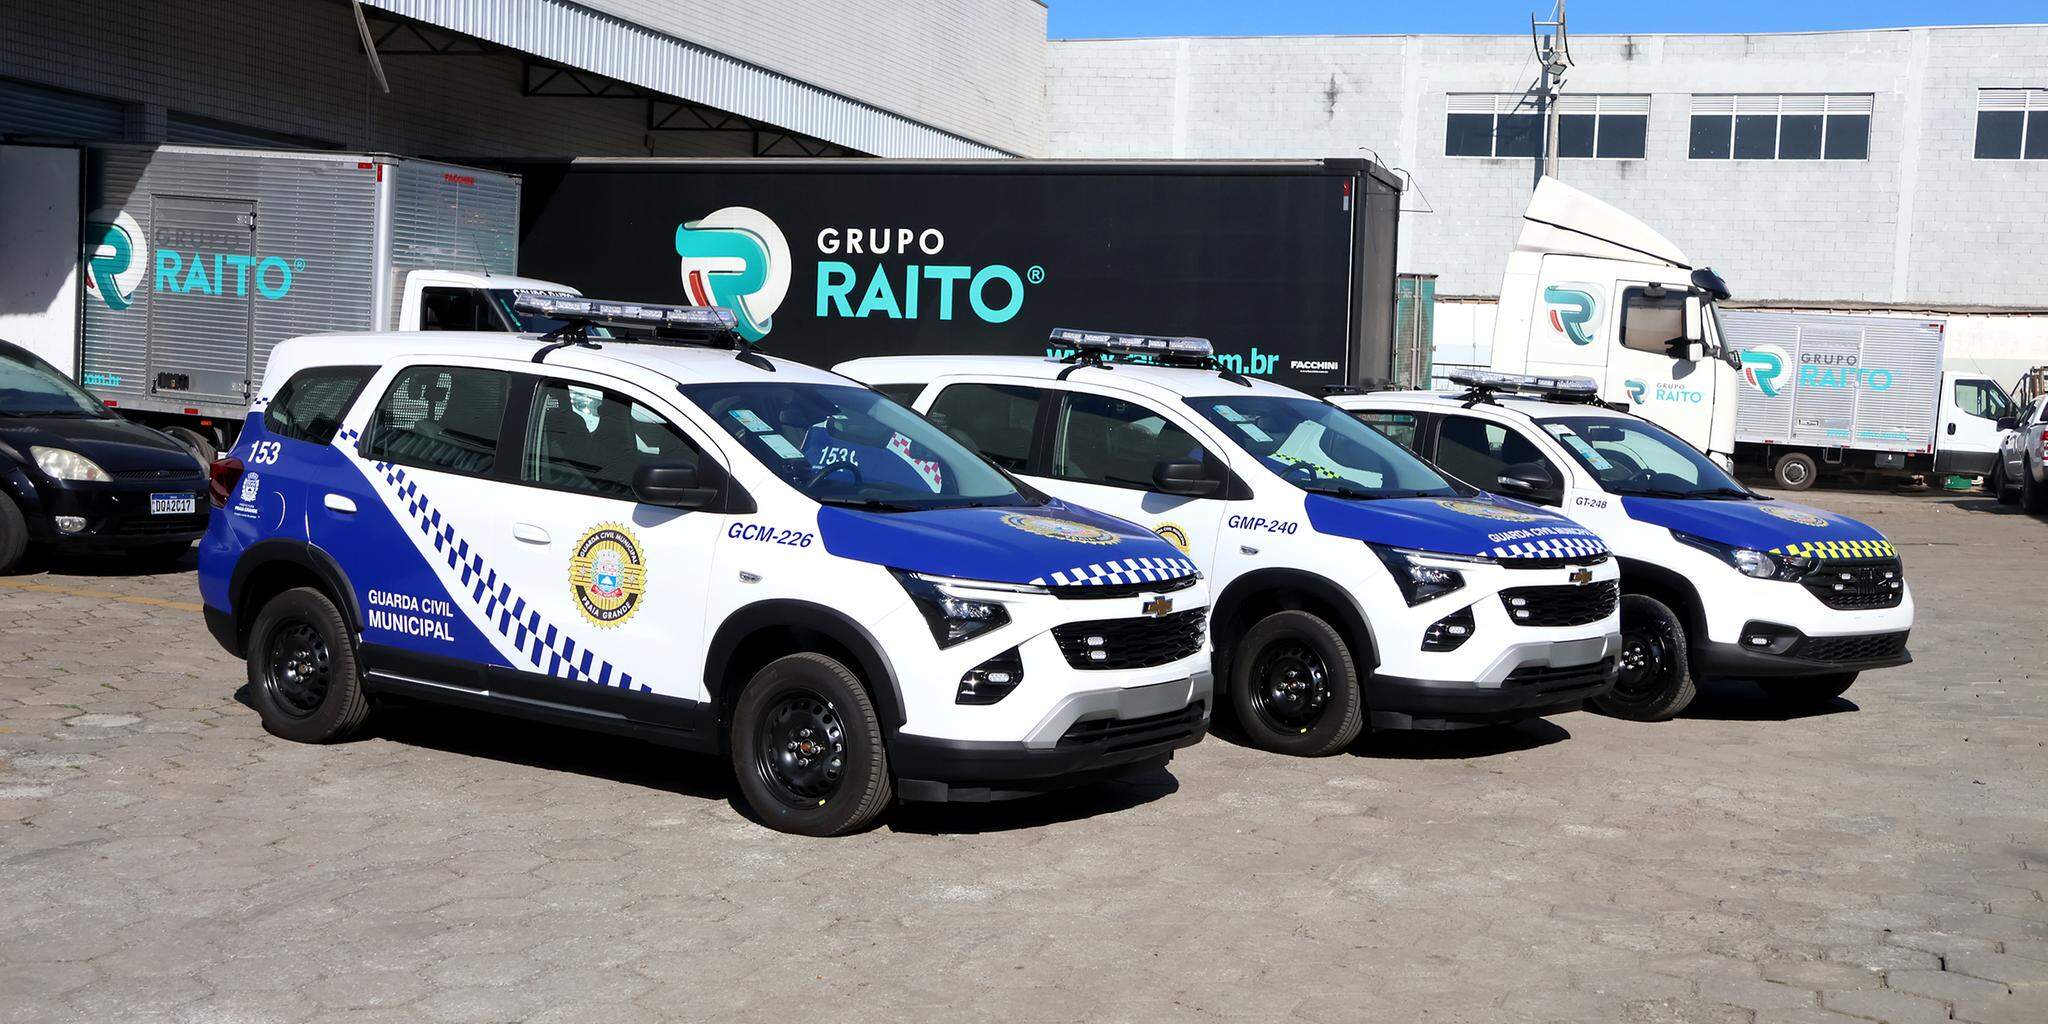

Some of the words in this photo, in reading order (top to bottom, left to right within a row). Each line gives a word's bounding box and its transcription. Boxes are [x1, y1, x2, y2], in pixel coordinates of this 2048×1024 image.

[817, 228, 945, 255] GRUPO
[1291, 360, 1338, 370] FACCHINI
[1801, 353, 1857, 366] GRUPO
[248, 440, 281, 465] 153
[1576, 496, 1607, 509] GT-248
[728, 522, 814, 548] GCM-226
[1228, 515, 1298, 535] GMP-240
[1488, 529, 1534, 543] GUARDA
[1530, 526, 1557, 536] CIVIL
[580, 535, 600, 557] GUARDA
[600, 531, 615, 539] CIVIL
[615, 532, 638, 564] MUNICIPAL
[368, 589, 419, 612] GUARDA
[422, 599, 454, 618] CIVIL
[582, 596, 599, 616] PRAIA
[602, 601, 632, 619] GRANDE
[368, 609, 455, 642] MUNICIPAL
